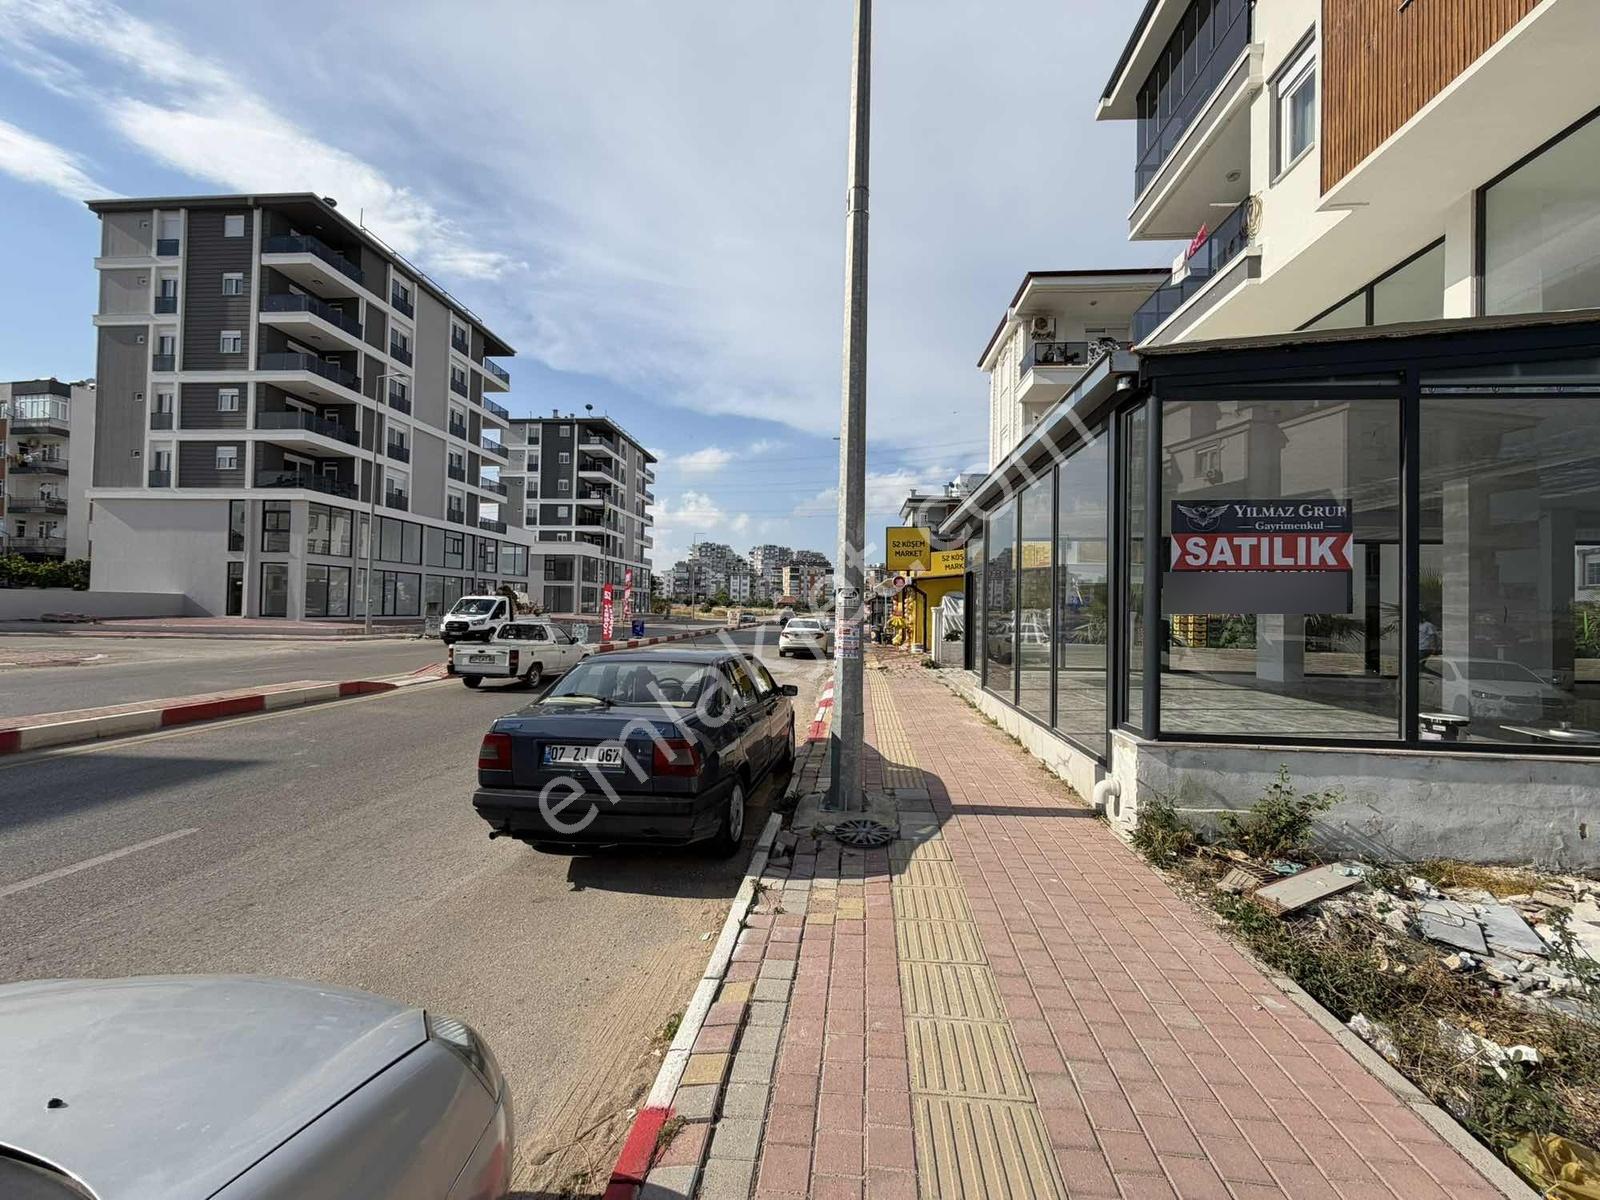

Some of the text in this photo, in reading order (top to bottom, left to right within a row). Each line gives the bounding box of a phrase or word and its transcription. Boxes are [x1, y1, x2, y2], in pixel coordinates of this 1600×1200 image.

[1298, 504, 1346, 517] GRUP
[1255, 521, 1324, 532] Gayrimenkul
[892, 540, 901, 548] 52
[1185, 536, 1338, 566] SATILIK
[552, 747, 566, 761] 07
[598, 748, 619, 762] 067
